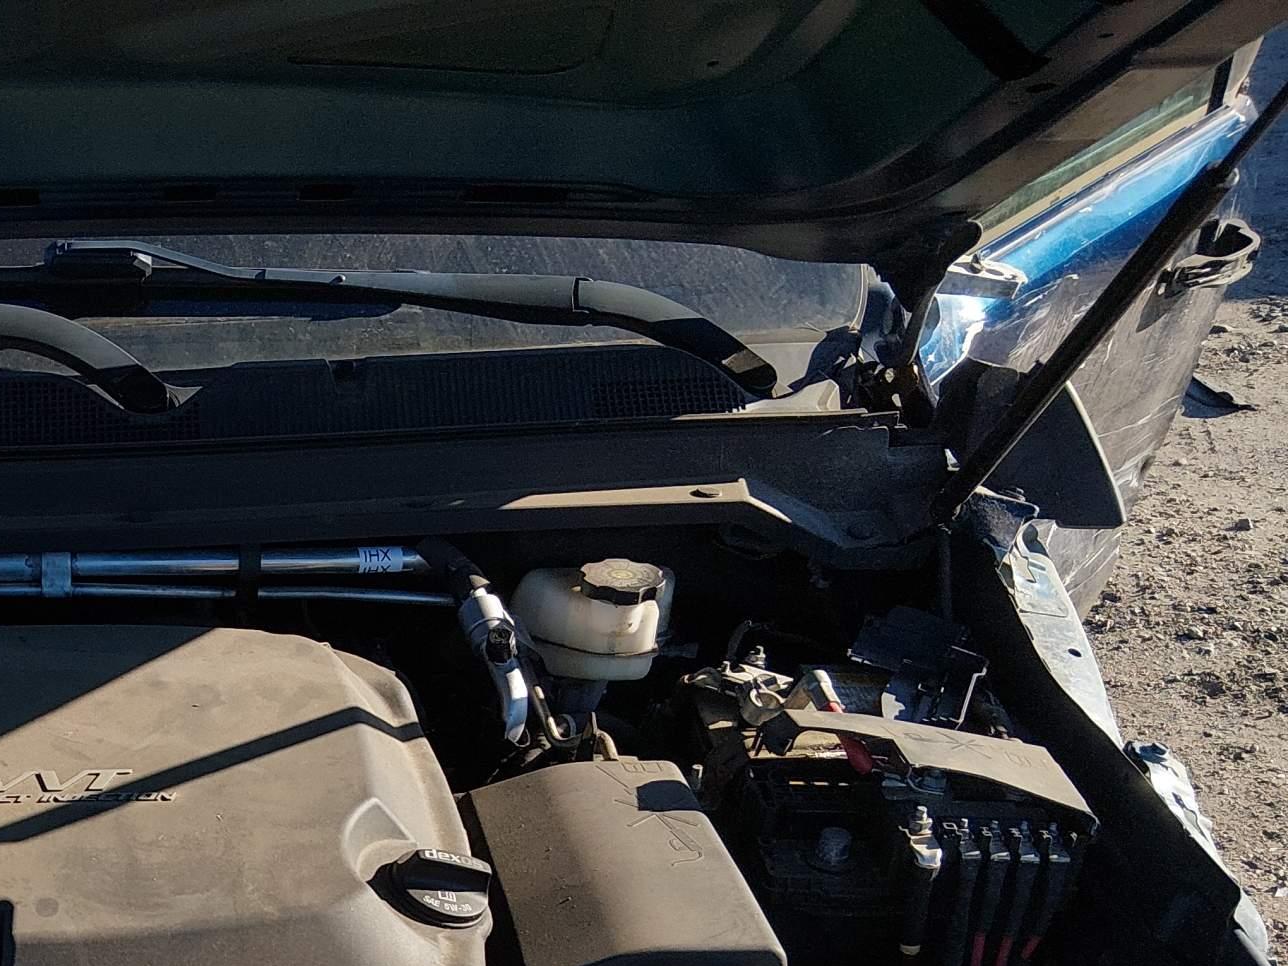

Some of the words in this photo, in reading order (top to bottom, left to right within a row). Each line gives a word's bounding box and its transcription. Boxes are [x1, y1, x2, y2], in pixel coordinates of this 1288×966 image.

[36, 791, 177, 805] INJECTION
[424, 848, 484, 869] dexos
[423, 895, 440, 907] SAE
[444, 903, 472, 912] 5W-30
